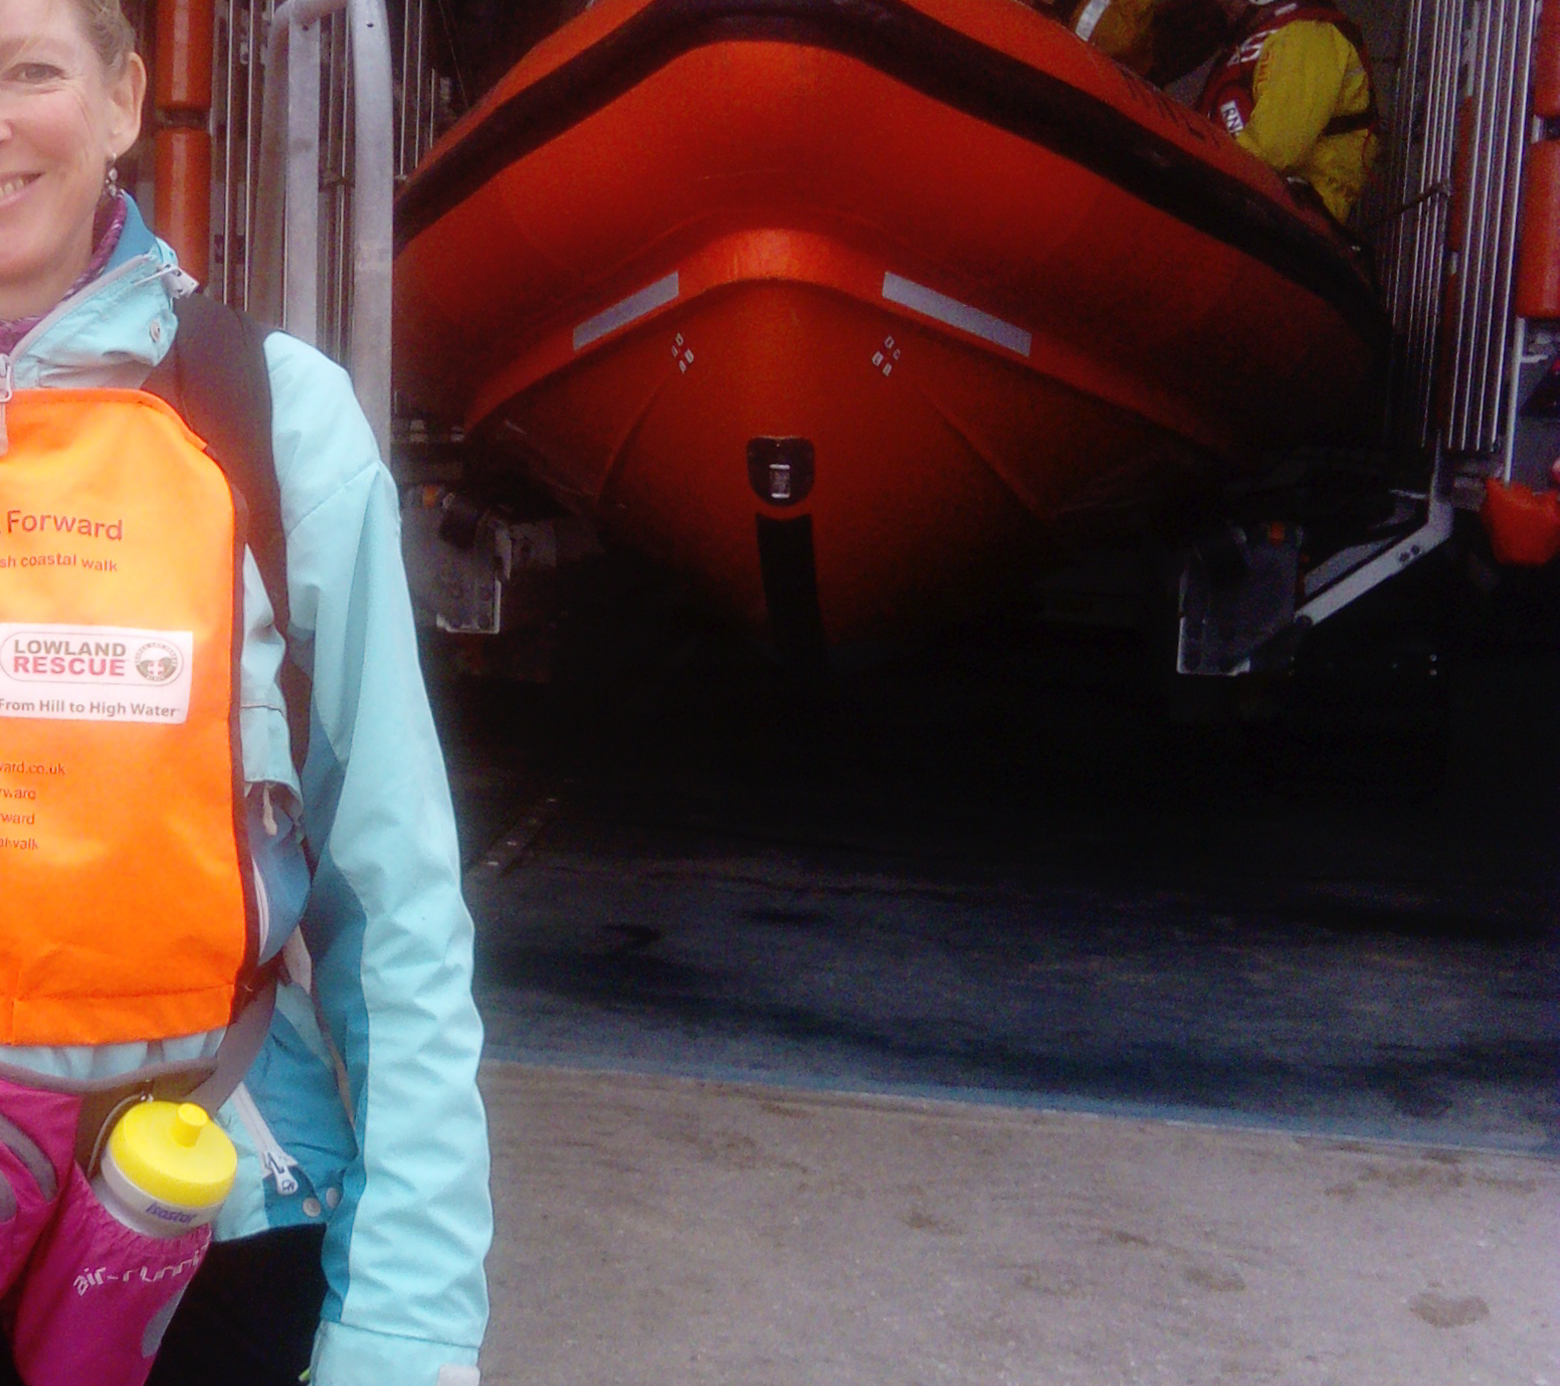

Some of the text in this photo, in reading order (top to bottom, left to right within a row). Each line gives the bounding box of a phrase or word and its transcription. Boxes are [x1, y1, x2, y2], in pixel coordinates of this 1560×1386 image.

[6, 510, 124, 541] Forward
[20, 551, 77, 567] coastal
[82, 556, 118, 573] walk
[14, 639, 127, 657] LOWLAND
[13, 656, 126, 677] RESCUE
[39, 699, 65, 713] Hill
[69, 701, 85, 714] to
[90, 701, 126, 718] High
[129, 703, 177, 718] Water
